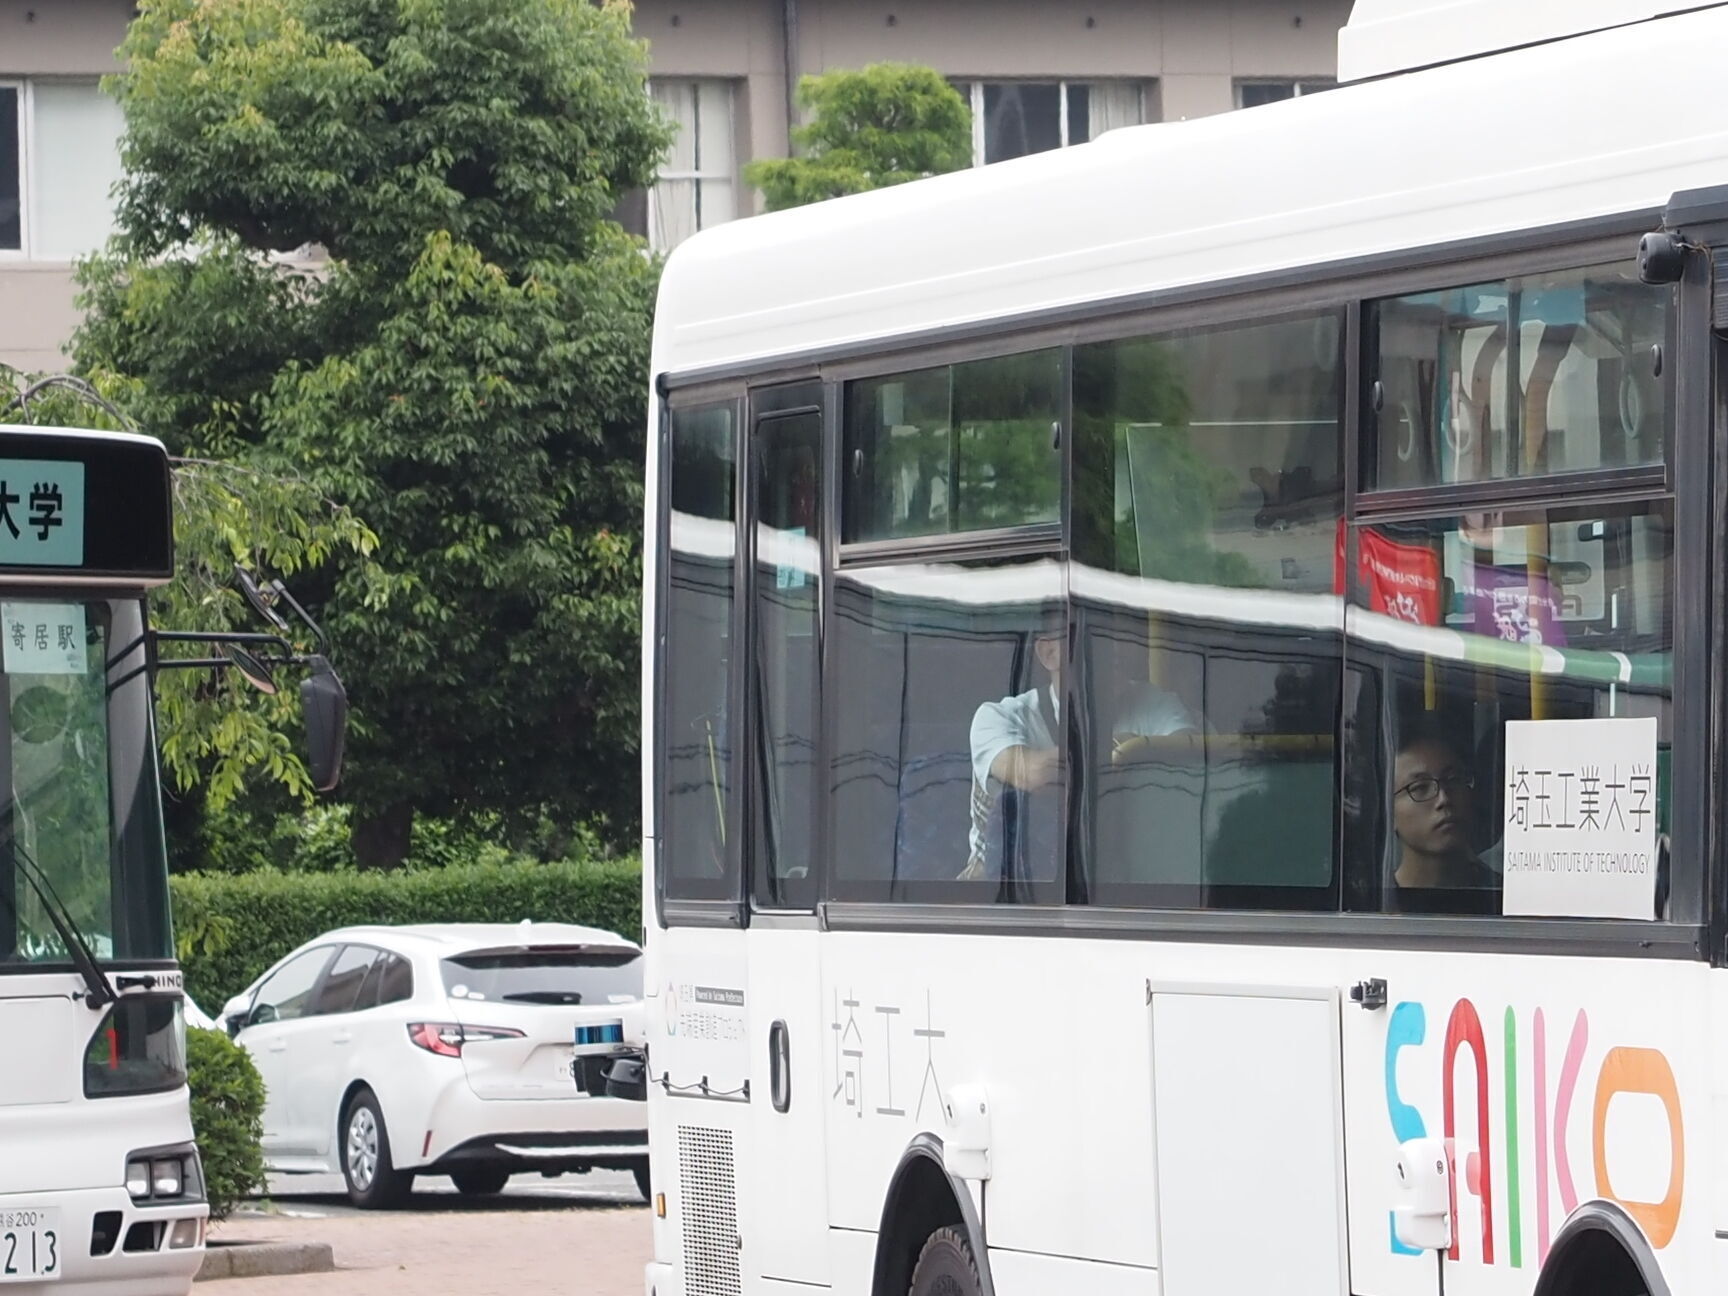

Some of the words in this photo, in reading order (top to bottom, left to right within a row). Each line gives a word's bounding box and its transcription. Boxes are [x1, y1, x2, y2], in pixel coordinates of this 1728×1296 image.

[10, 622, 76, 651] 寄居駅
[1508, 764, 1651, 833] 埼玉工業大学
[1507, 852, 1542, 872] SAITAMA
[1544, 852, 1581, 873] INSTITUTE
[1583, 853, 1595, 873] OF
[1597, 853, 1651, 874] TECHNOLOGY
[1385, 997, 1685, 1269] SAIKO
